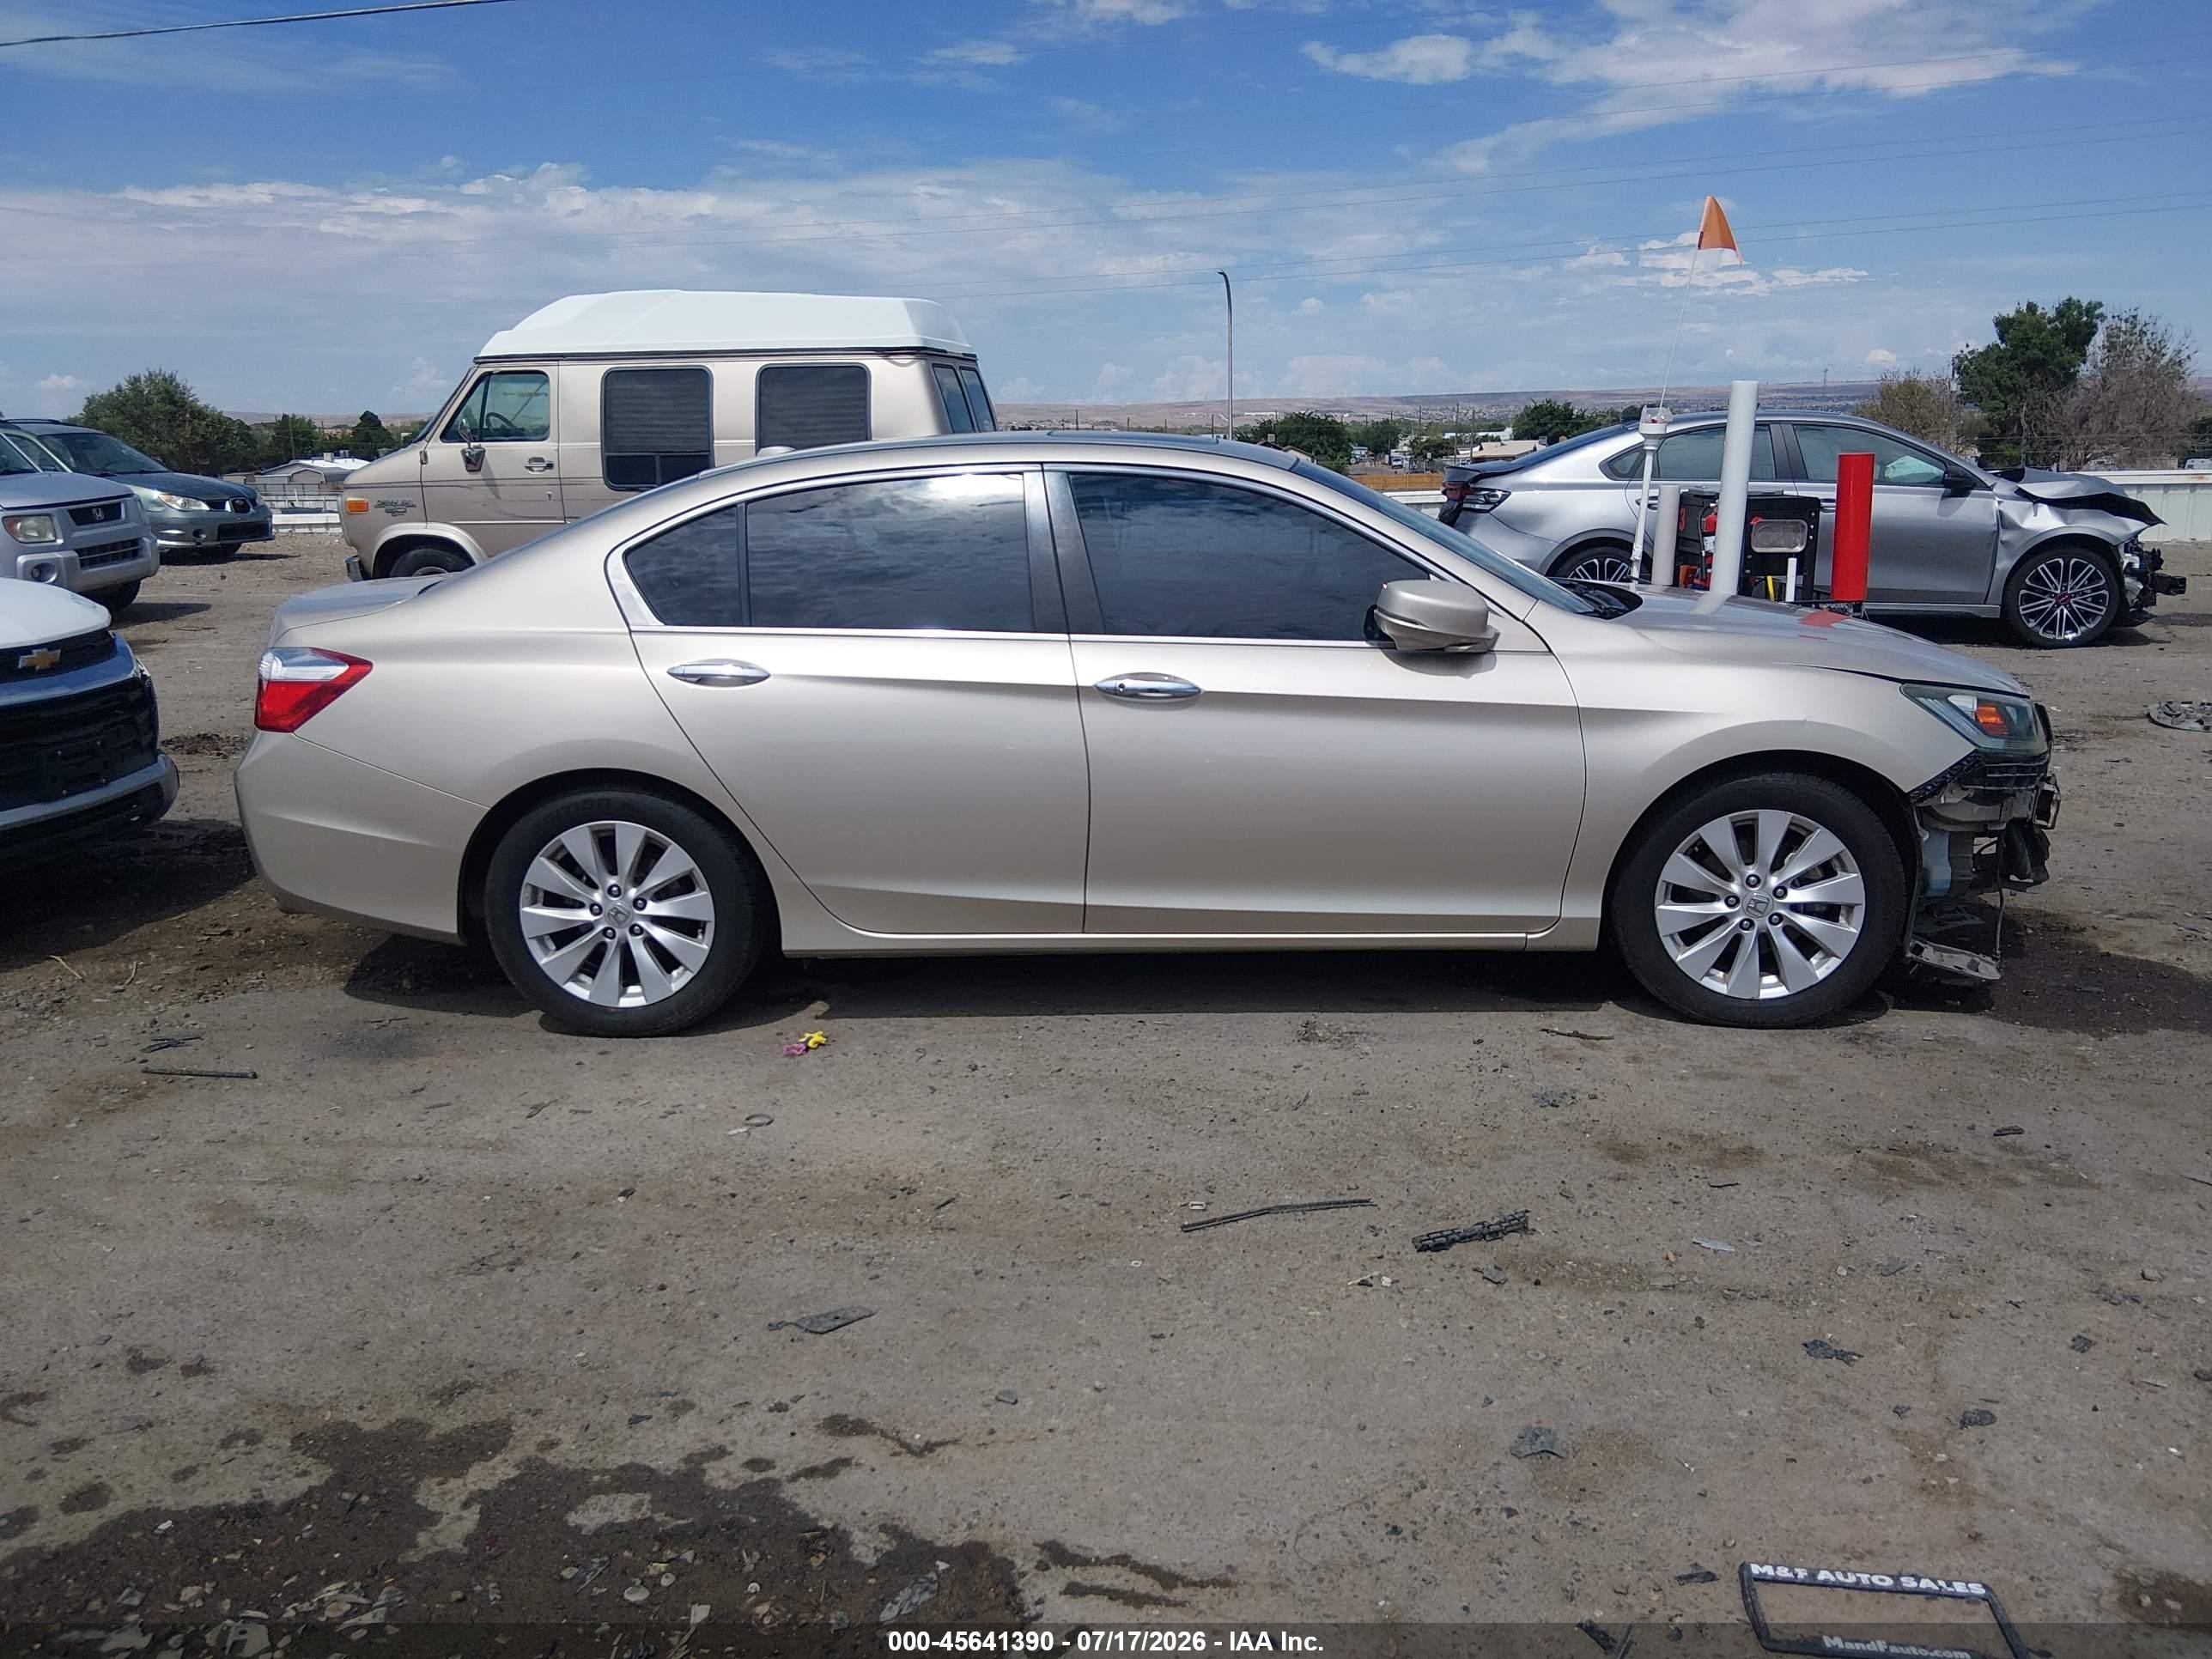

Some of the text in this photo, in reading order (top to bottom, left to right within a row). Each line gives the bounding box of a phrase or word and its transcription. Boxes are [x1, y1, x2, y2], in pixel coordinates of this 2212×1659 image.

[1750, 1563, 1986, 1595] M&F AUTO SALES
